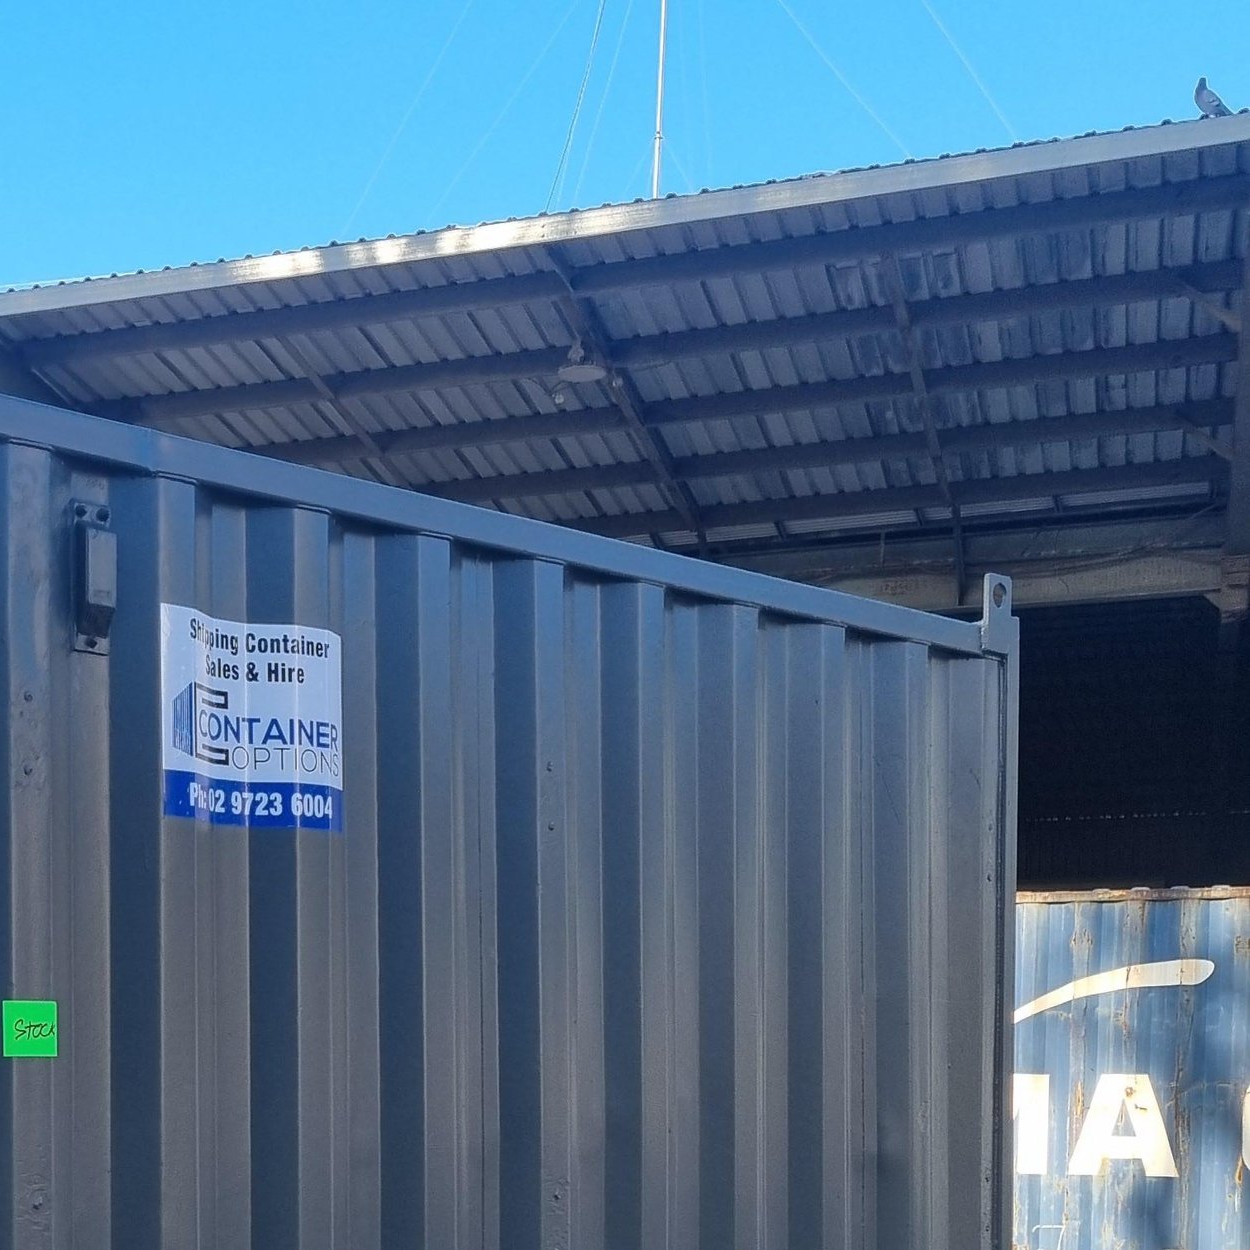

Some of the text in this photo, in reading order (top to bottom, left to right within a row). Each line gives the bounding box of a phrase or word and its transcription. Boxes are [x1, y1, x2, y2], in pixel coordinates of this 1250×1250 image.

[190, 618, 329, 658] Shipping Container
[206, 655, 305, 683] Sales & Hire
[199, 709, 338, 751] CONTAINER
[232, 746, 339, 777] OPTIONS
[231, 792, 283, 816] 9723
[291, 793, 333, 819] 6004
